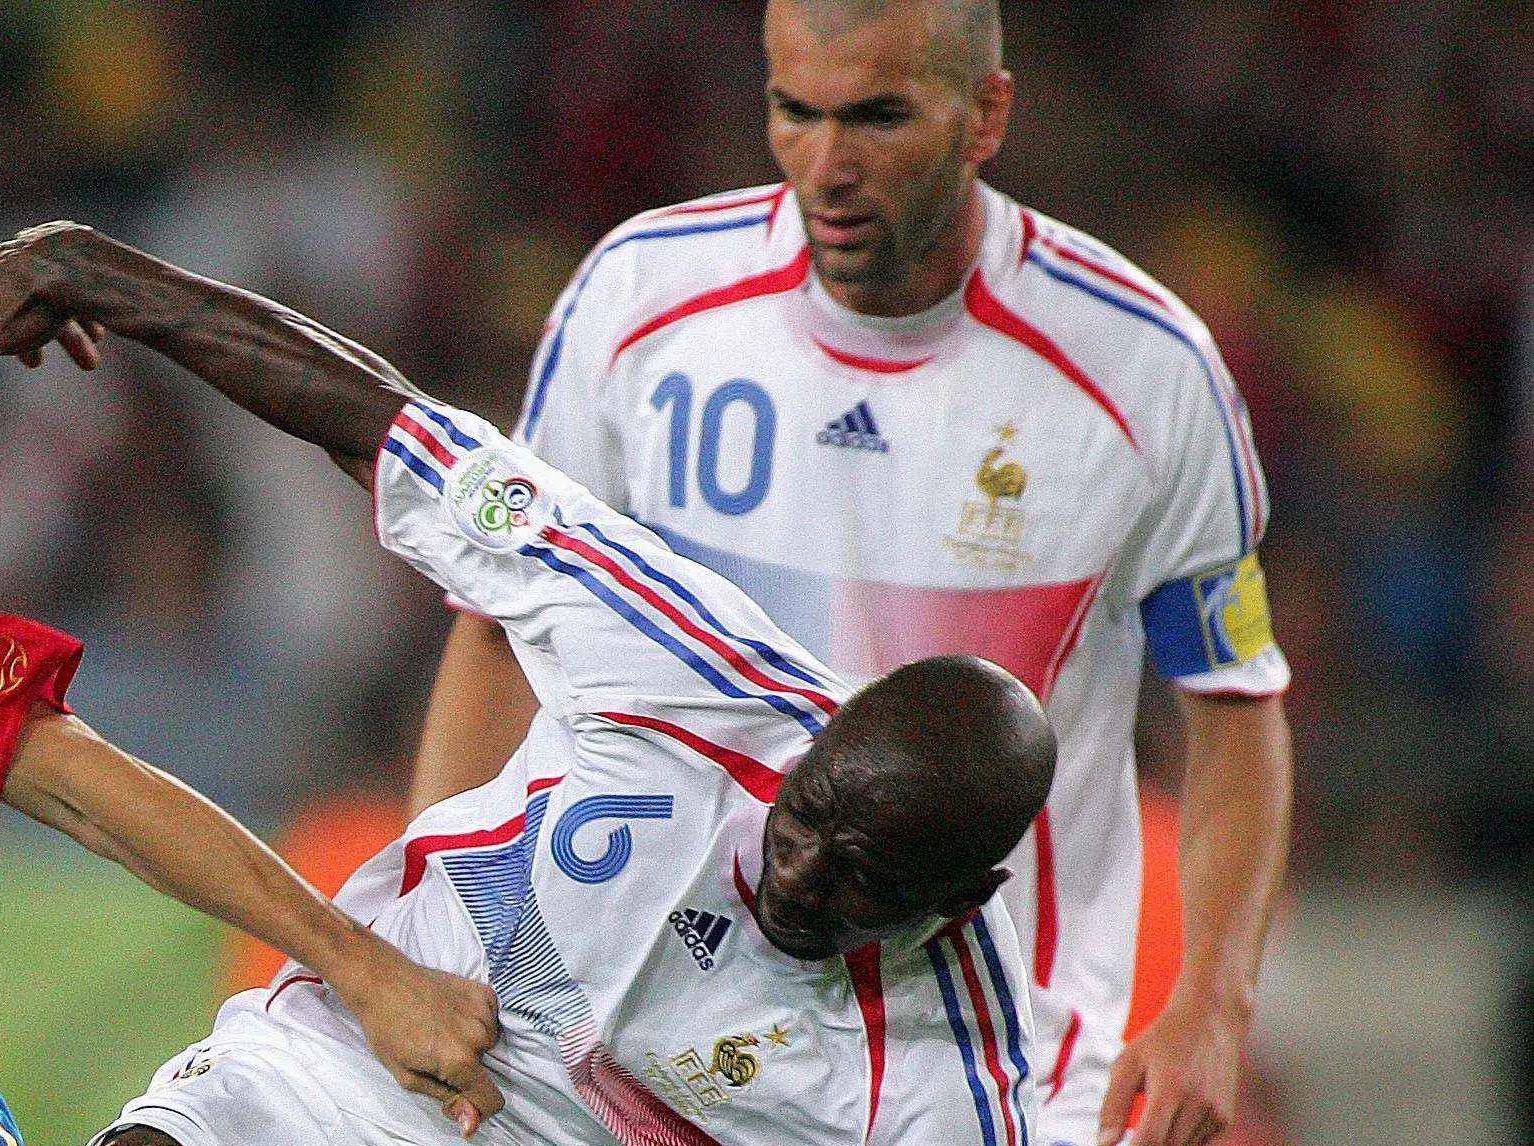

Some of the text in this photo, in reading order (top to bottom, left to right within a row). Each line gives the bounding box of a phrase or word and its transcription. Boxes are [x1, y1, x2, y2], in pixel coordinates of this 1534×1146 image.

[650, 370, 778, 516] 10
[550, 794, 674, 884] 6
[668, 910, 714, 971] adidas
